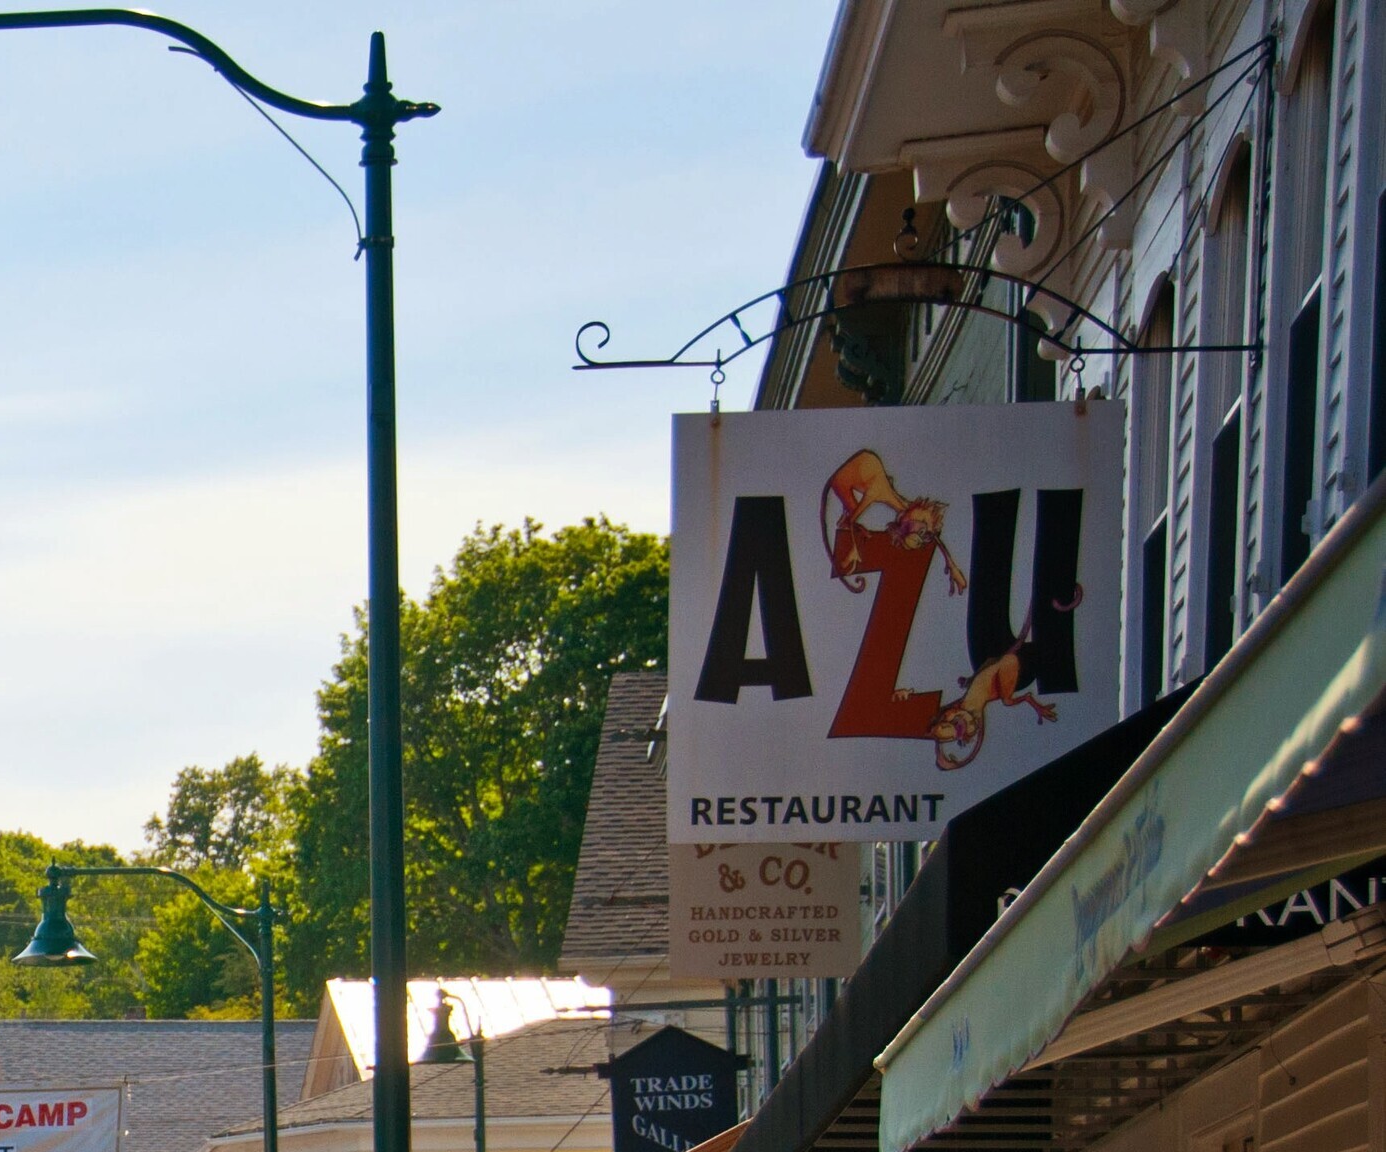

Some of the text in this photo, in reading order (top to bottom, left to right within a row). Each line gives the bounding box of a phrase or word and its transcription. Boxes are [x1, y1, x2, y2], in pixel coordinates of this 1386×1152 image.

[691, 794, 945, 826] RESTAURANT
[718, 856, 812, 895] & CO.
[690, 905, 839, 920] HANDCRAFTED
[688, 928, 841, 943] GOLD & SILVER
[718, 953, 811, 966] JEWELRY
[630, 1074, 713, 1093] TRADE
[633, 1093, 713, 1111] WINDS
